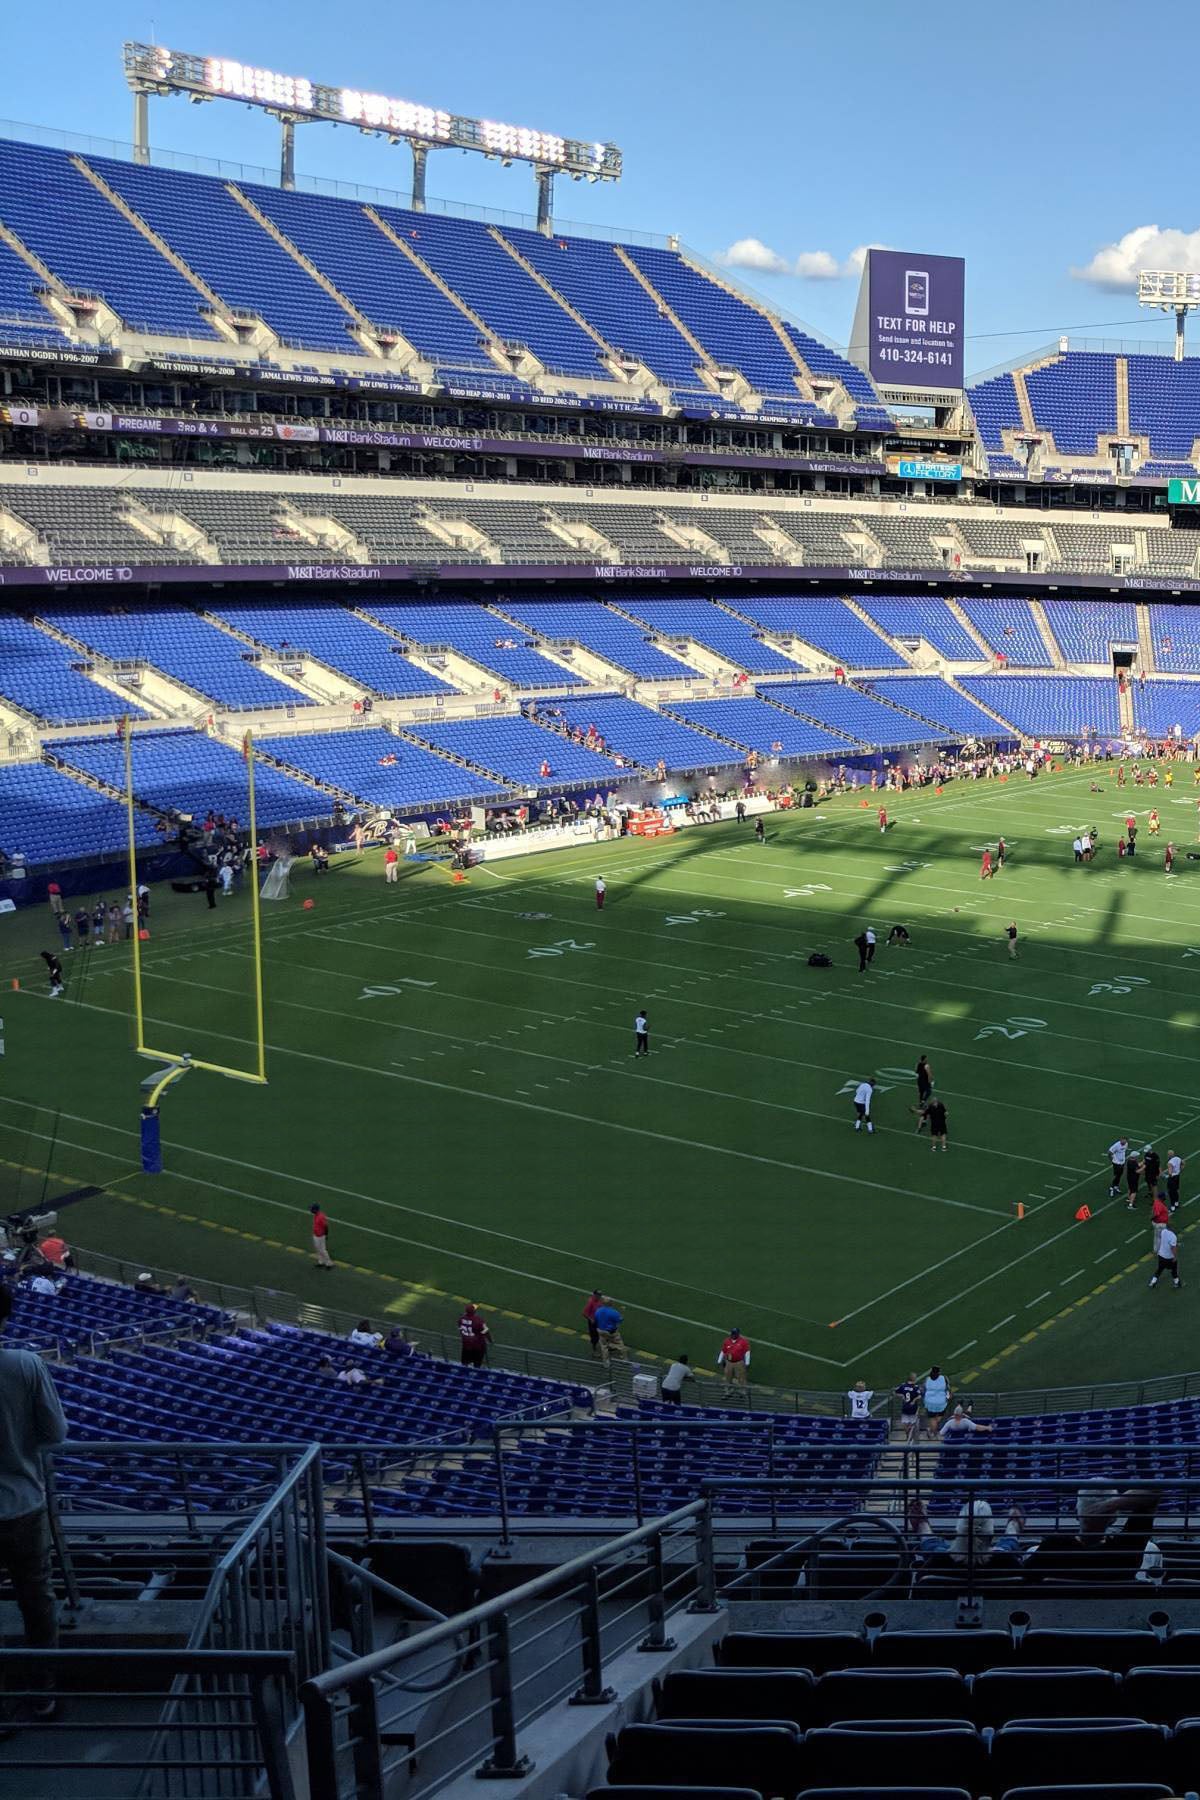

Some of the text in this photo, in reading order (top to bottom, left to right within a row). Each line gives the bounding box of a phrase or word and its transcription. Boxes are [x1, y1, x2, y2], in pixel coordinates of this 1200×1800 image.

[877, 316, 955, 334] TEXT FOR HELP
[878, 335, 893, 343] Send
[31, 351, 58, 360] OGDEN
[60, 353, 99, 364] 1996-2007
[880, 348, 952, 366] 410-324-6141
[154, 361, 172, 371] MATT
[173, 363, 199, 373] STOVER
[261, 371, 281, 380] JAMAL
[602, 403, 631, 411] SMYTH
[741, 413, 759, 421] WORLD
[118, 417, 162, 431] PREGAME
[177, 421, 218, 434] 3RD & 4
[230, 427, 247, 435] BALL
[260, 426, 274, 437] 25
[326, 429, 350, 442] M&T
[350, 431, 374, 444] Bank
[374, 432, 410, 446] Stadium
[423, 436, 471, 449] WELCOME
[583, 448, 653, 461] M&T Bank Stadium
[45, 568, 133, 582] WELCOME TO
[288, 566, 380, 579] M&T Bank Stadium
[595, 566, 666, 578] M&T Bank Stadium
[689, 566, 743, 577] WELCOME TO
[848, 570, 923, 581] M&T Bank Stadium
[1124, 578, 1200, 591] M&T Bank Stadium
[527, 939, 597, 958] 20
[362, 977, 438, 996] 10
[1091, 975, 1151, 995] 30
[979, 1016, 1048, 1040] 20
[856, 1400, 864, 1409] 12
